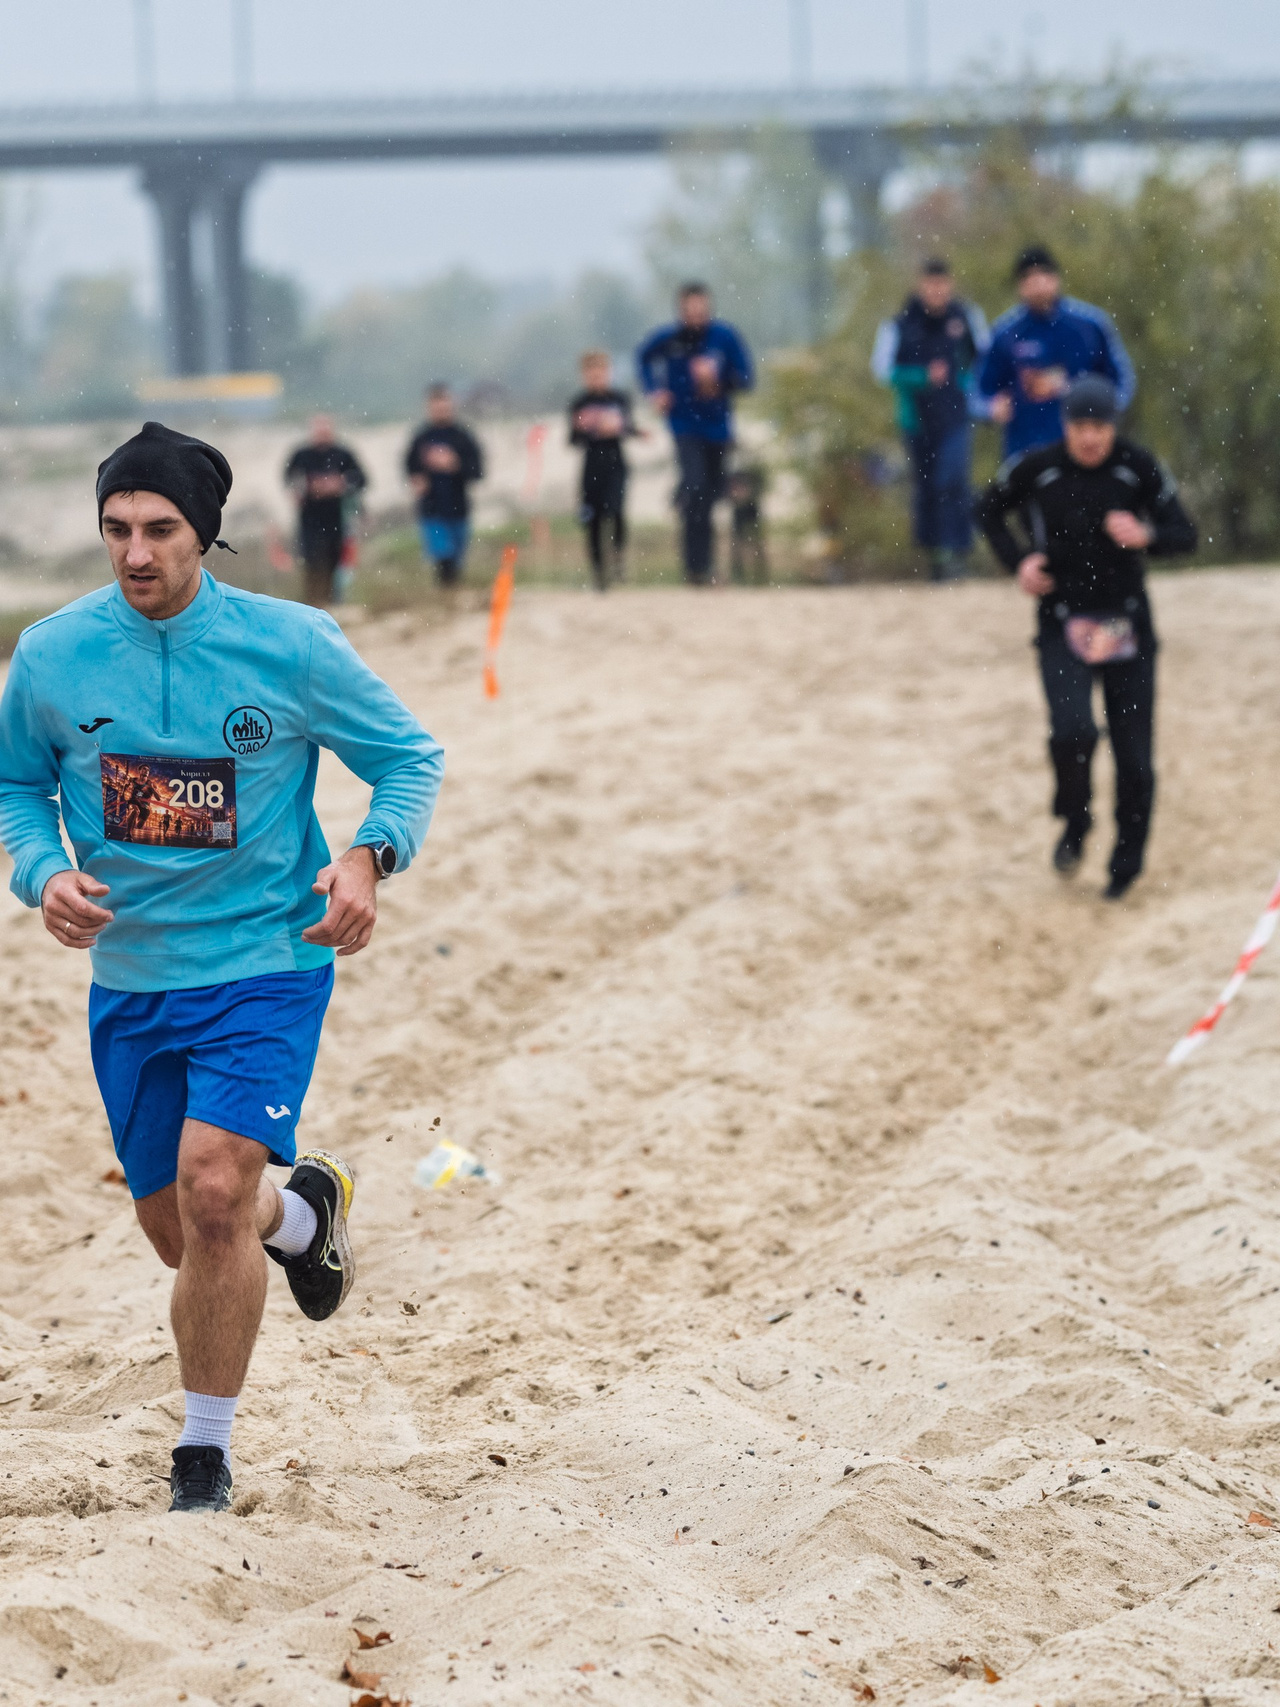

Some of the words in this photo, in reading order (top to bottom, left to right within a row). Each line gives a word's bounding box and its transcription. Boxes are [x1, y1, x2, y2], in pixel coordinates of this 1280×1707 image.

[238, 742, 261, 755] ОАО
[180, 769, 211, 779] Кирилл
[168, 779, 224, 808] 208
